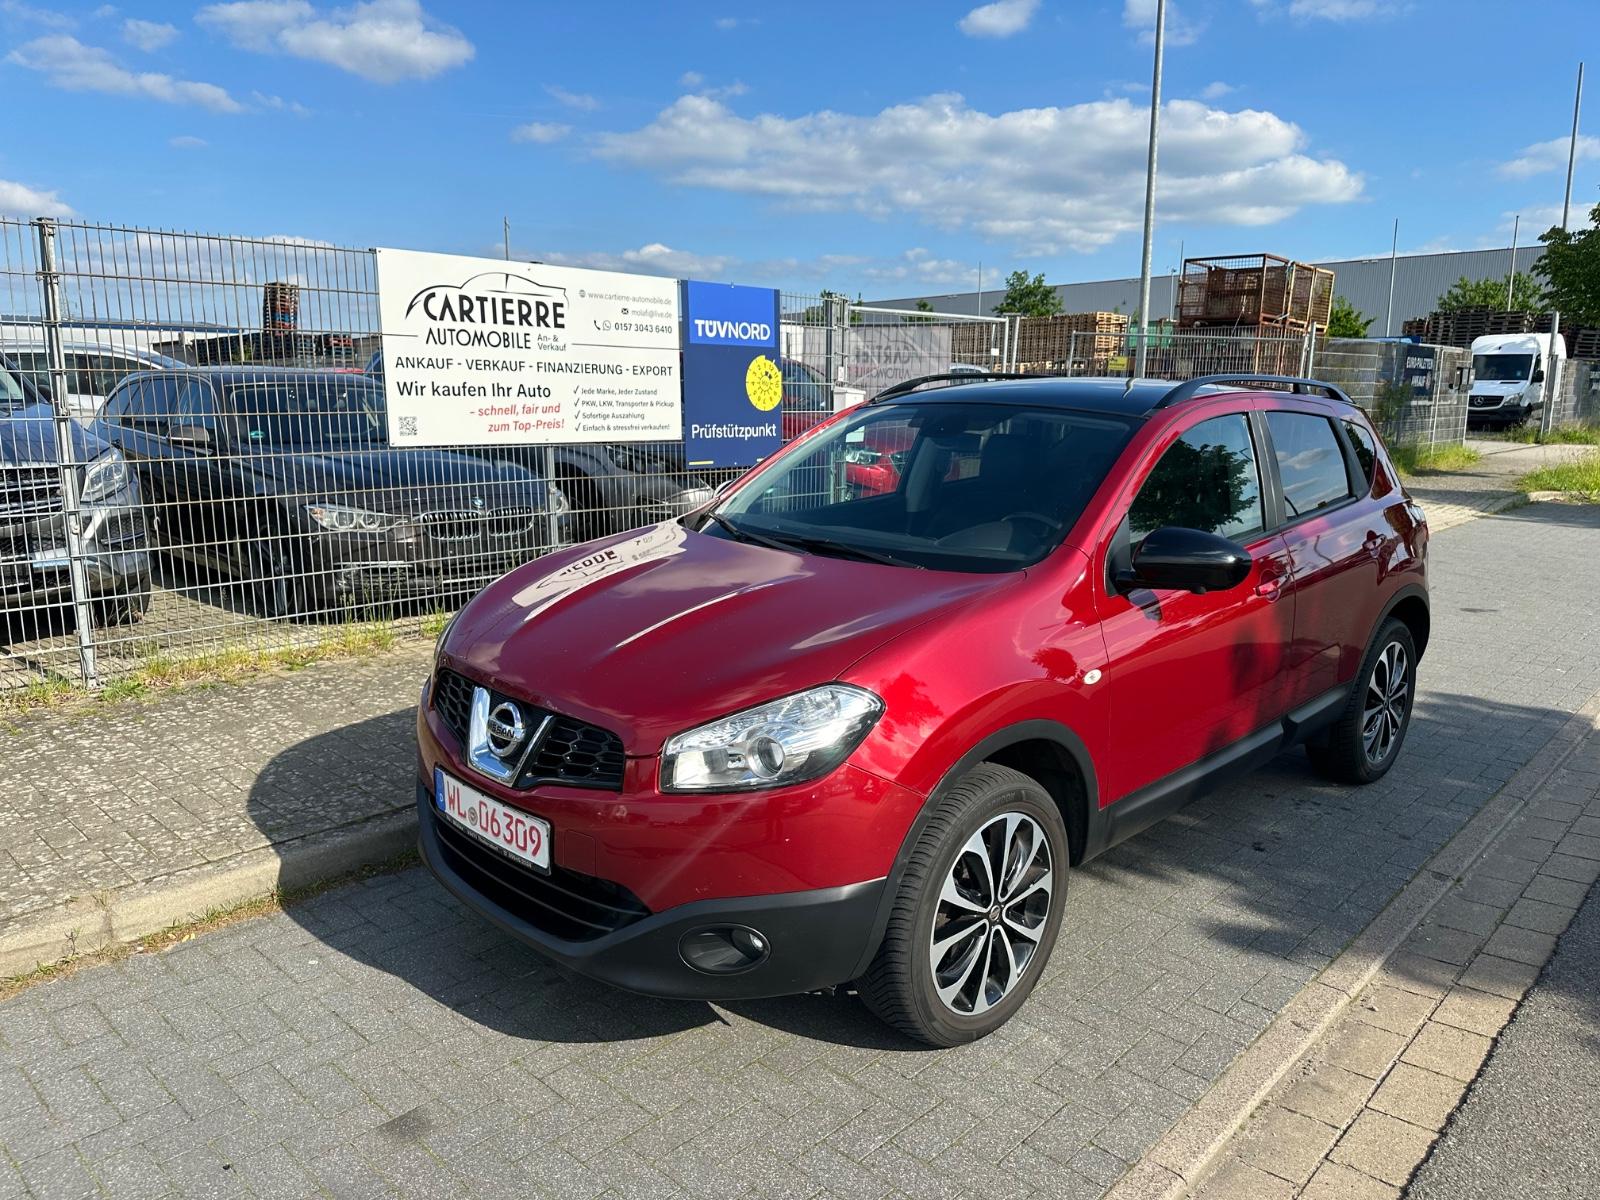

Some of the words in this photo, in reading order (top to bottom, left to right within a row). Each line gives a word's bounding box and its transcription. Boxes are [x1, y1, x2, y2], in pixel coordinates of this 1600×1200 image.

[423, 291, 566, 329] CARTIERRE
[614, 322, 632, 331] 0157
[634, 323, 654, 333] 3043
[655, 325, 673, 334] 6410
[425, 327, 532, 349] AUTOMOBILE
[537, 333, 551, 342] An-
[552, 334, 559, 342] &
[537, 342, 567, 352] Verkauf
[395, 356, 453, 370] ANKAUF
[465, 359, 526, 372] VERKAUF
[536, 361, 623, 375] FINANZIERUNG
[632, 365, 673, 377] EXPORT
[396, 381, 426, 397] Wir
[431, 381, 486, 397] kaufen
[492, 382, 512, 398] Ihr
[517, 383, 551, 398] Auto
[597, 387, 616, 395] Marke,
[478, 404, 519, 417] schnell,
[521, 403, 538, 415] fair
[541, 402, 561, 414] und
[616, 400, 648, 408] Transporter
[656, 400, 674, 408] Pickup
[582, 412, 610, 420] Sofortige
[612, 412, 645, 420] Auszahlung
[488, 423, 510, 433] zum
[513, 419, 565, 433] Top-Preis!
[641, 423, 670, 431] verkaufen!
[691, 423, 777, 441] Prüfstützpunkt
[446, 780, 467, 819] WL
[479, 800, 541, 857] 06309
